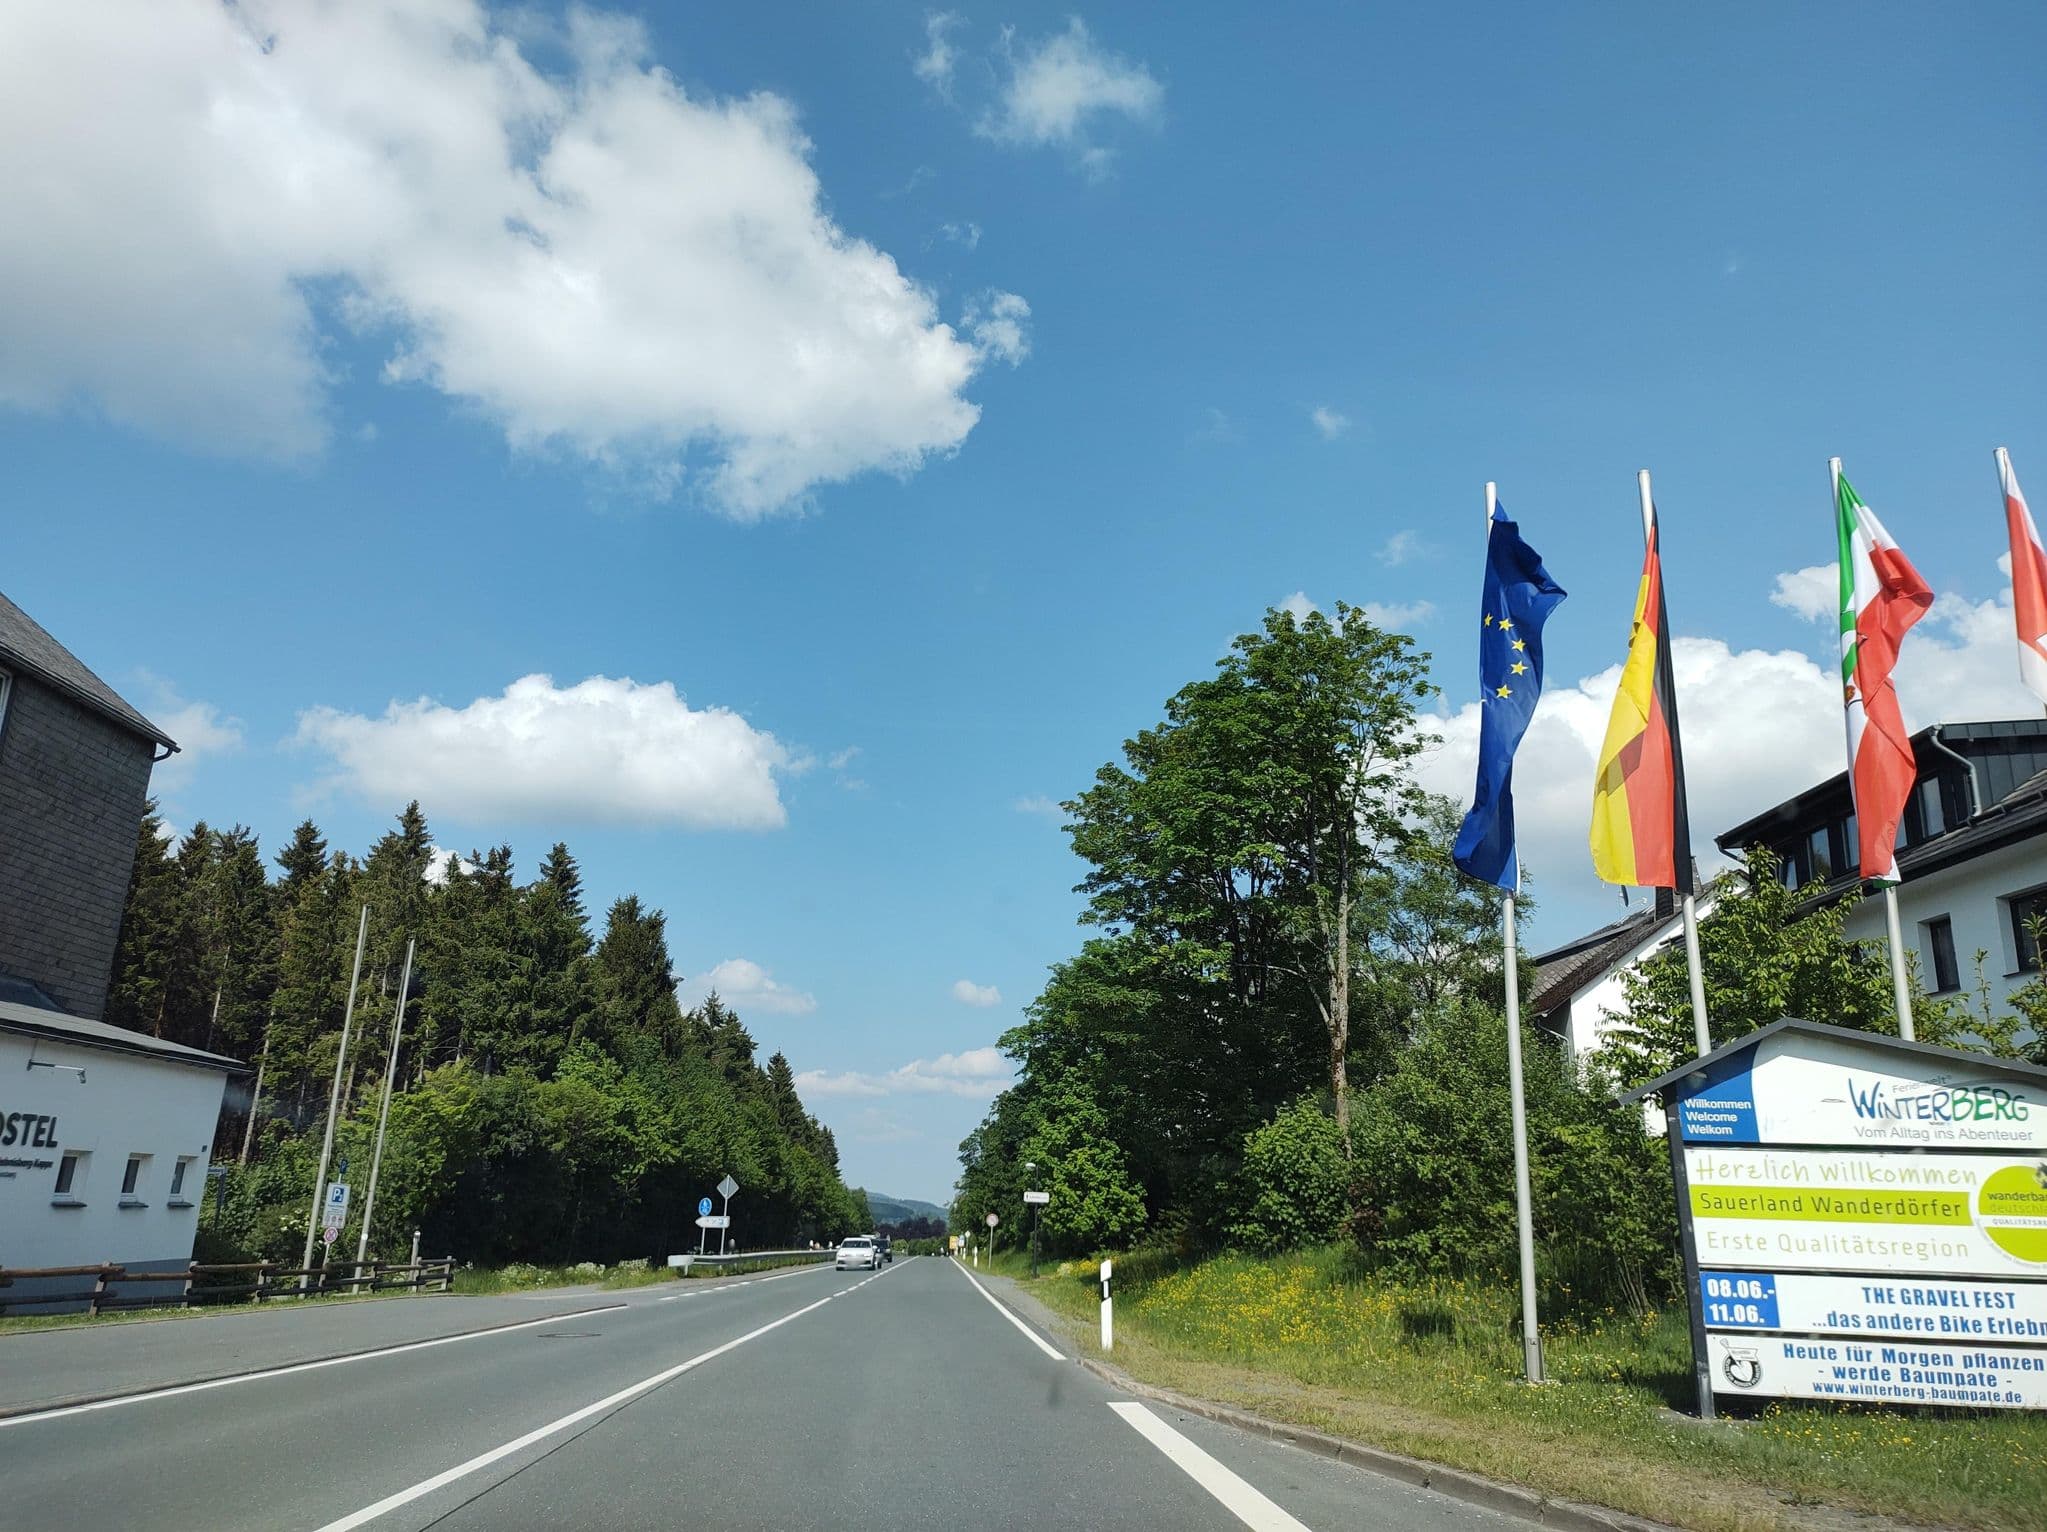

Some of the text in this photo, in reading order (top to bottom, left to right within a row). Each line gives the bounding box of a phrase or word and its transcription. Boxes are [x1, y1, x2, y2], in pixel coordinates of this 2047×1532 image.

[1684, 1099, 1752, 1110] Willkommen
[1686, 1111, 1738, 1122] Welcome
[1687, 1124, 1733, 1135] Welkom
[1854, 1126, 2032, 1141] Vom Alltag ins Abenteuer
[1696, 1154, 1977, 1185] Herzlich willkommen
[1700, 1193, 1961, 1217] Sauerland Wanderdörfer
[1987, 1192, 2047, 1201] wanderba
[1707, 1232, 1767, 1250] Erste
[1778, 1233, 1969, 1261] Qualitätsregion
[1862, 1287, 2015, 1309] THE GRAVEL FEST
[1710, 1303, 1765, 1323] 11.06.
[1866, 1313, 1934, 1331] andere
[1939, 1315, 1982, 1333] Bike
[1783, 1343, 2044, 1371] Heute für Morgen pflanzen
[1832, 1366, 1891, 1382] werde
[1900, 1367, 1997, 1387] Baumpate
[1812, 1382, 2021, 1403] www.winterberg-baumpate.de
